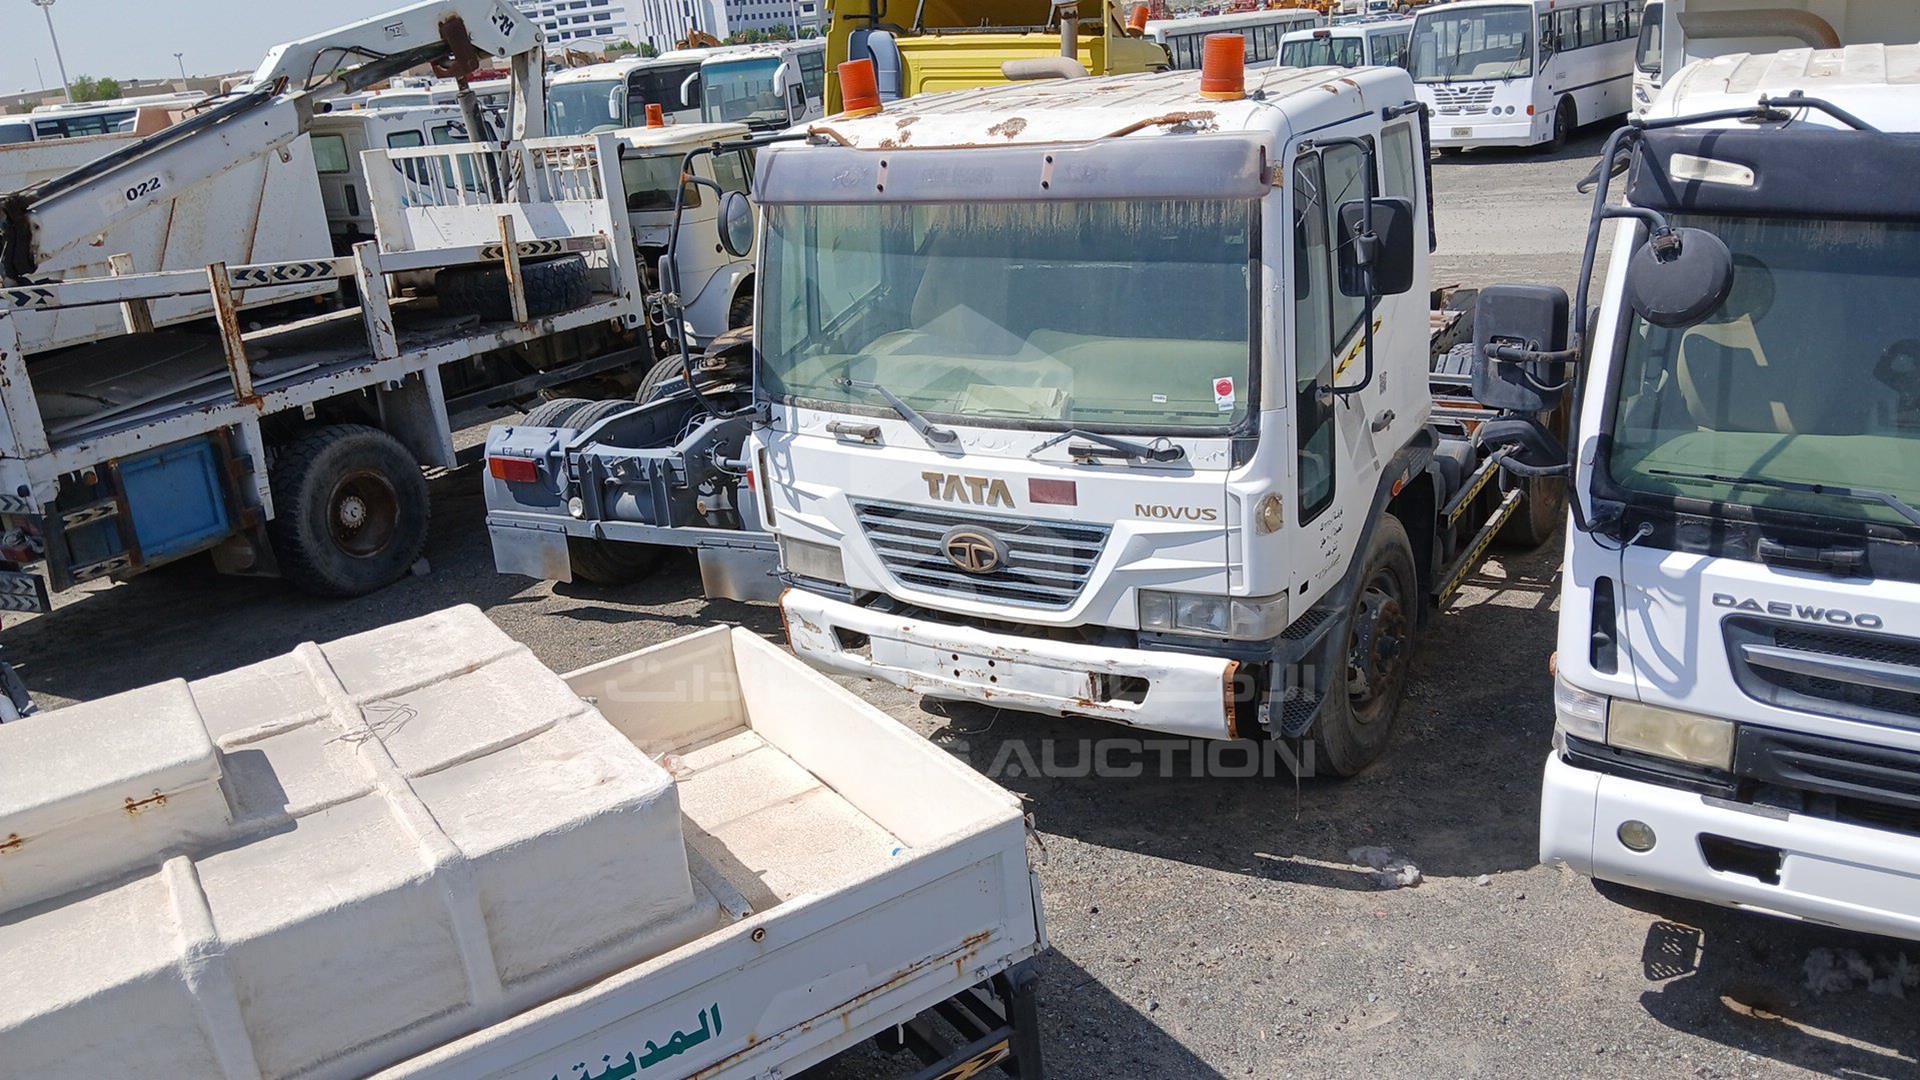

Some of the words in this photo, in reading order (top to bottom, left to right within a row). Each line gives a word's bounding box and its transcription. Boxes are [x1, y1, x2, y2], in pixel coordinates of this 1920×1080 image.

[126, 177, 161, 201] 022
[922, 472, 1016, 509] TATA
[1135, 504, 1218, 521] NOVUS
[1712, 593, 1883, 629] DAEWOO
